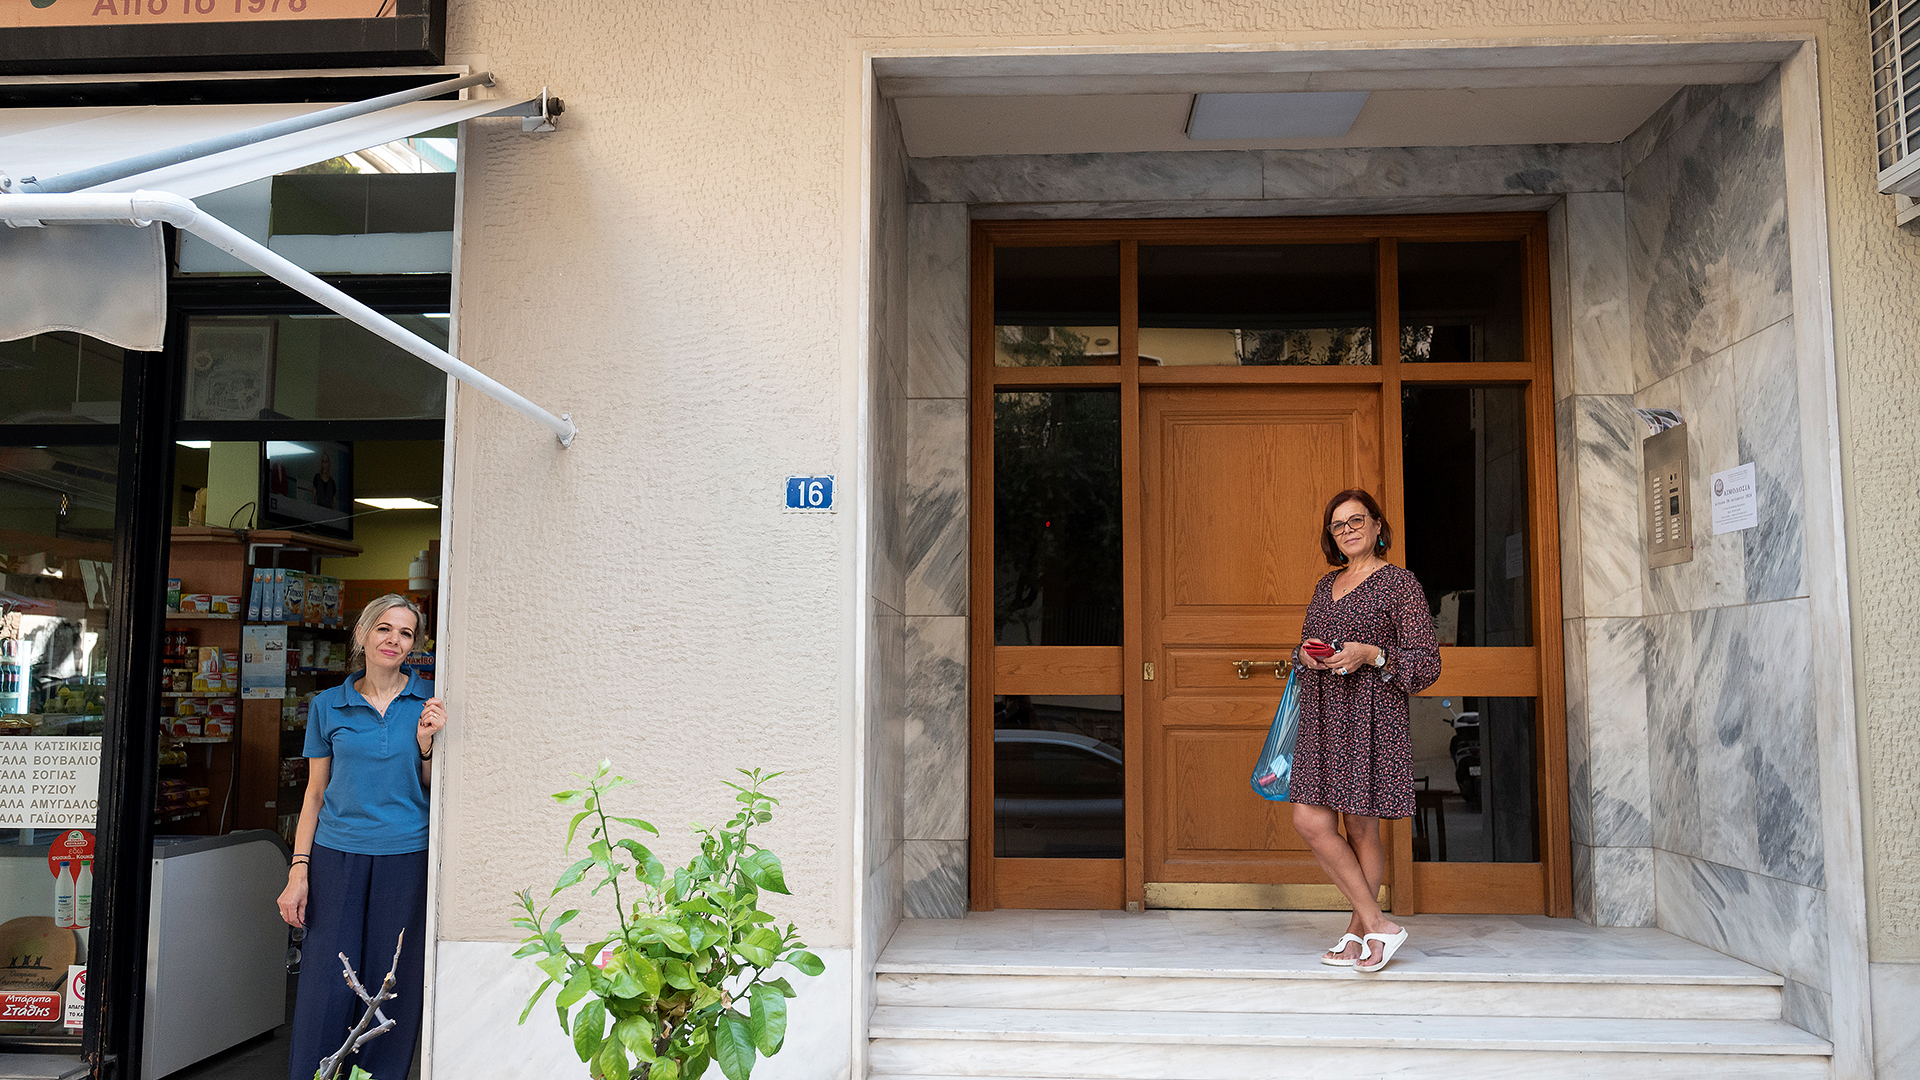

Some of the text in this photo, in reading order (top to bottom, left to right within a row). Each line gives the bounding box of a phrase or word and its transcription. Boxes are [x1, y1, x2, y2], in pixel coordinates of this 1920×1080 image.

[798, 481, 824, 506] 16
[34, 741, 102, 751] ΚΑΤΣΙΚΙΣΙΟ
[33, 756, 101, 766] ΒΟΥΒΑΛΙΟ
[0, 770, 77, 780] ΑΛΑ ΣΟΓΙΑΣ
[0, 785, 77, 795] ΑΛΑ ΡΥΖΙΟΥ
[0, 799, 25, 809] ΑΛΑ
[0, 814, 24, 823] ΑΛΑ
[5, 994, 52, 1005] Μπάρμπα
[2, 1004, 51, 1017] Στάθης
